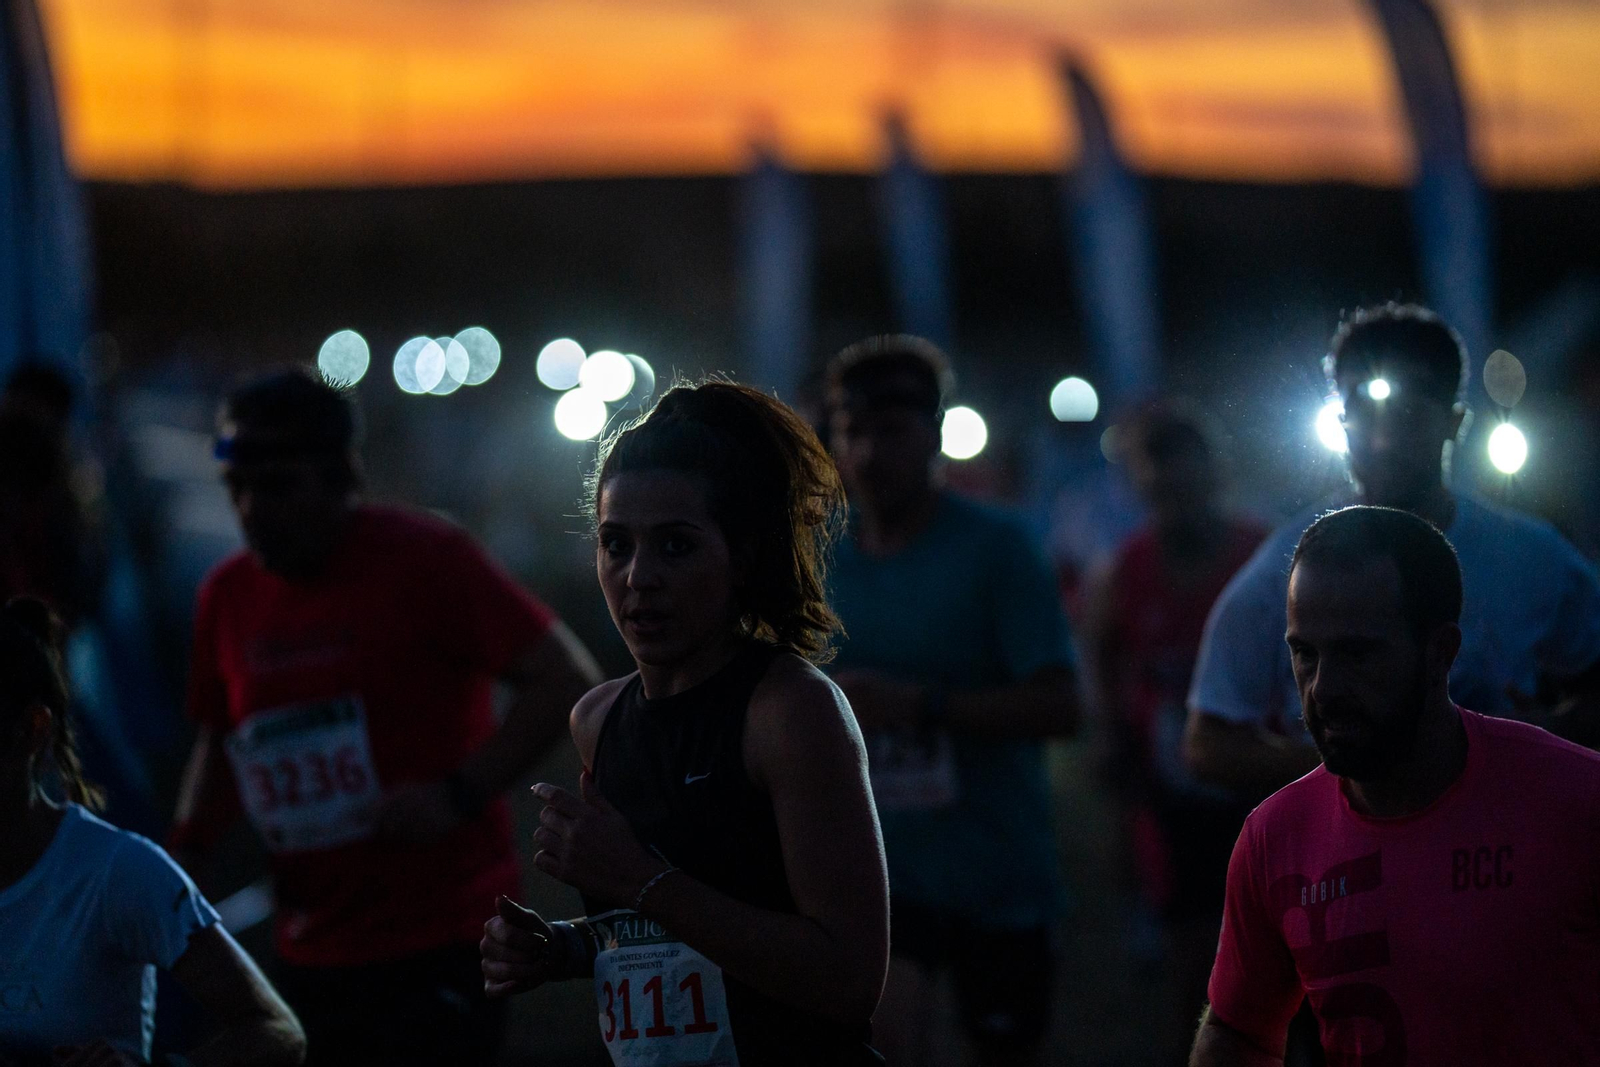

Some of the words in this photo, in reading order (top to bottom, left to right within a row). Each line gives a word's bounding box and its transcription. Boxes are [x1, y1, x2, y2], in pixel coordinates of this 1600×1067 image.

[246, 746, 368, 811] 3236
[1301, 875, 1348, 907] GOBIK
[1451, 845, 1514, 893] BCC
[614, 915, 667, 940] TÁLIC
[603, 972, 719, 1042] 3111
